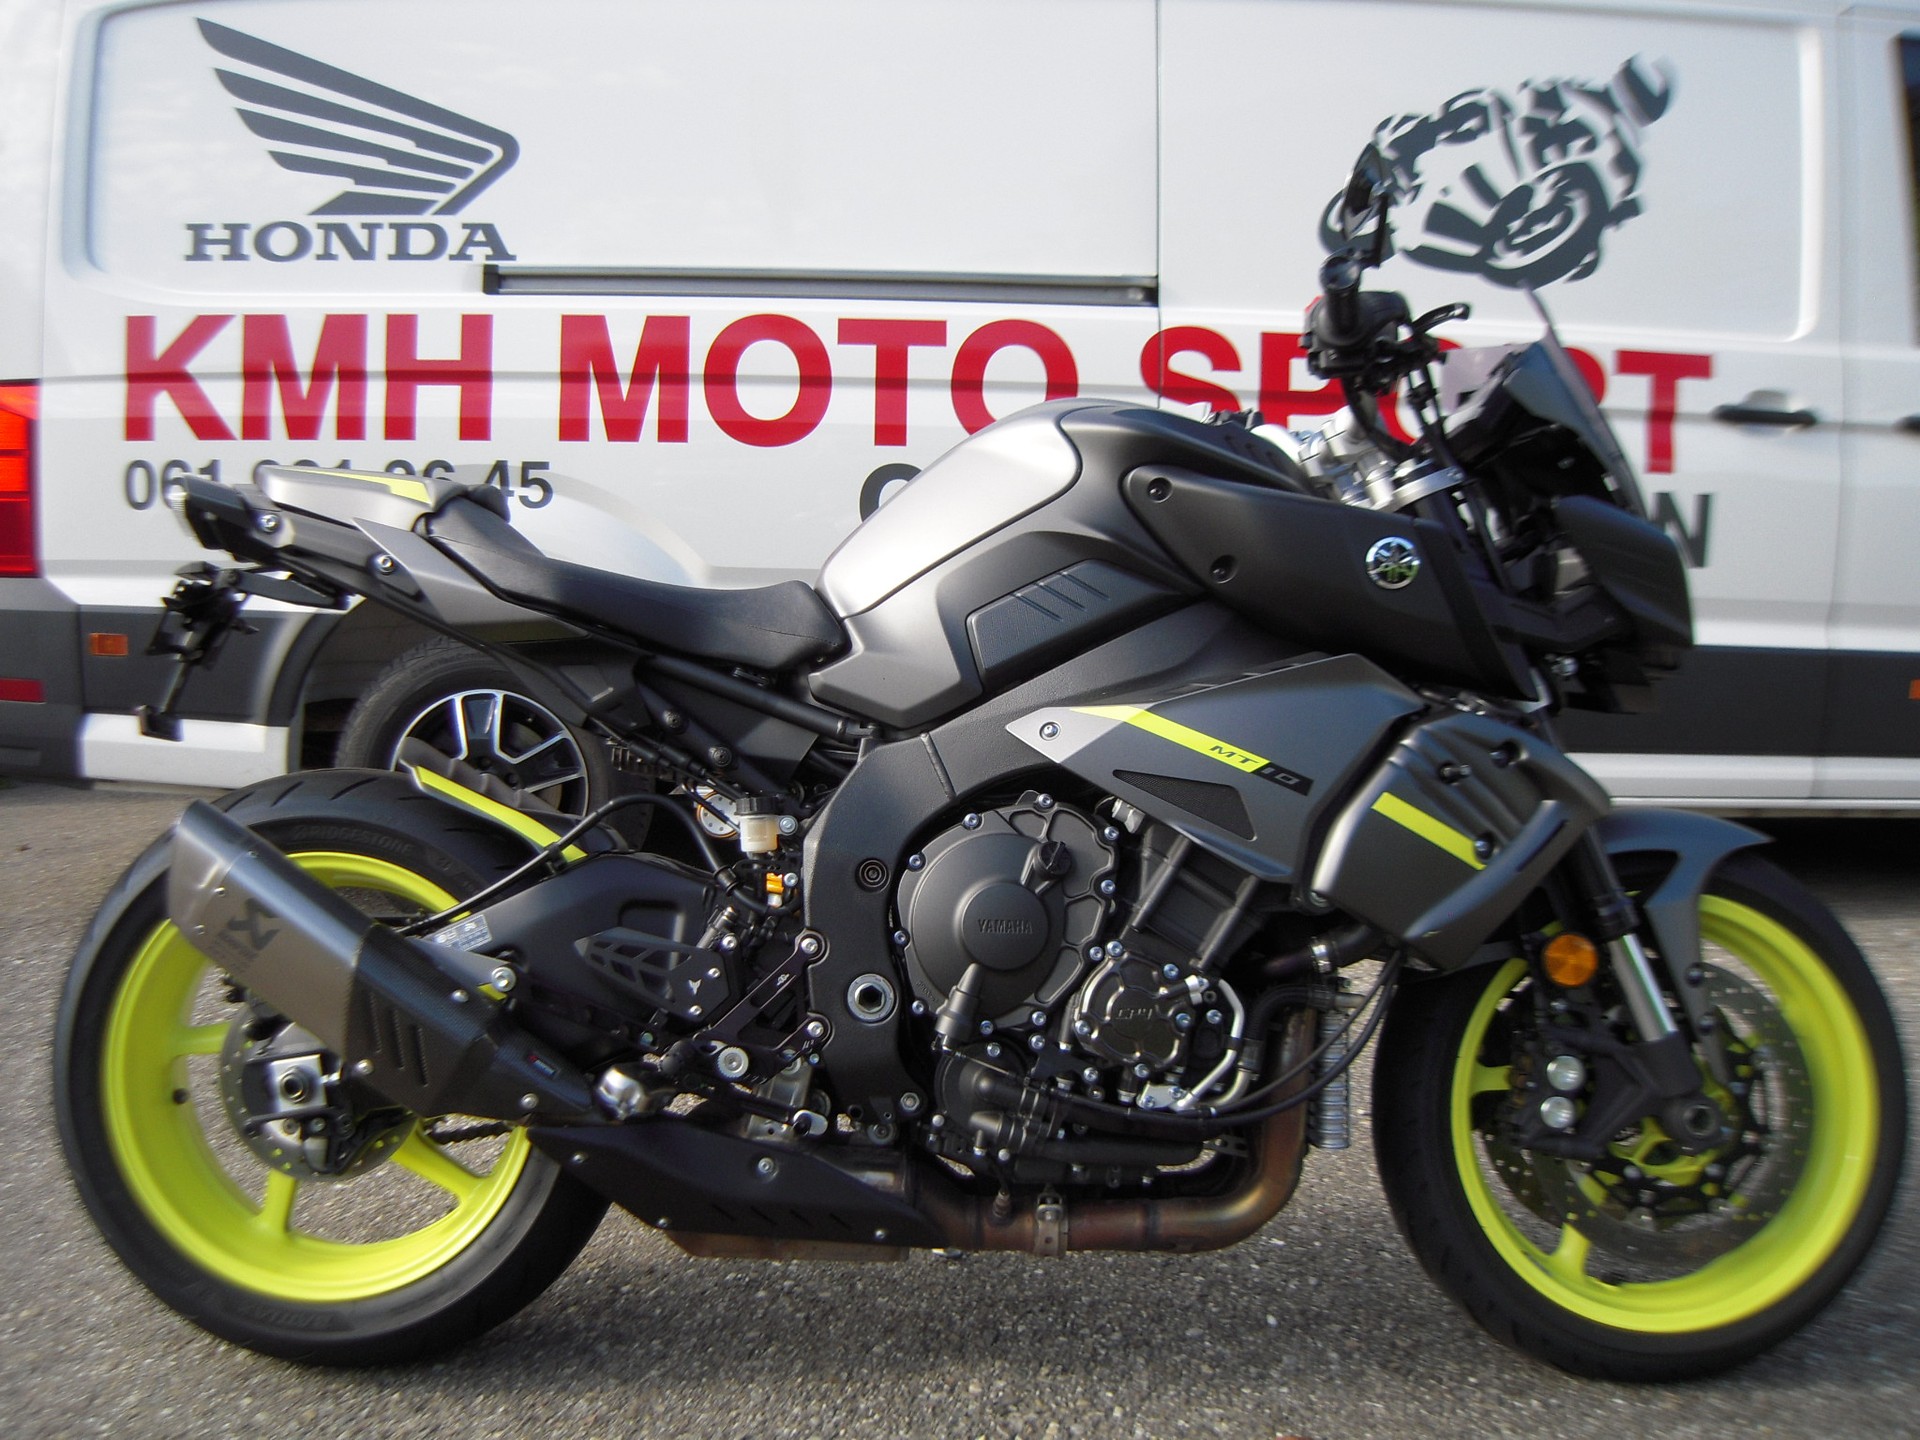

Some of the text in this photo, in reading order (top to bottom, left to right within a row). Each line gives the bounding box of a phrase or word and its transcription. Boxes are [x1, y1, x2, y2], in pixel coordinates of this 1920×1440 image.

[184, 221, 517, 261] HONDA
[123, 313, 494, 442] KMH
[558, 313, 1079, 447] MOTO
[977, 918, 1034, 935] YAMAHA
